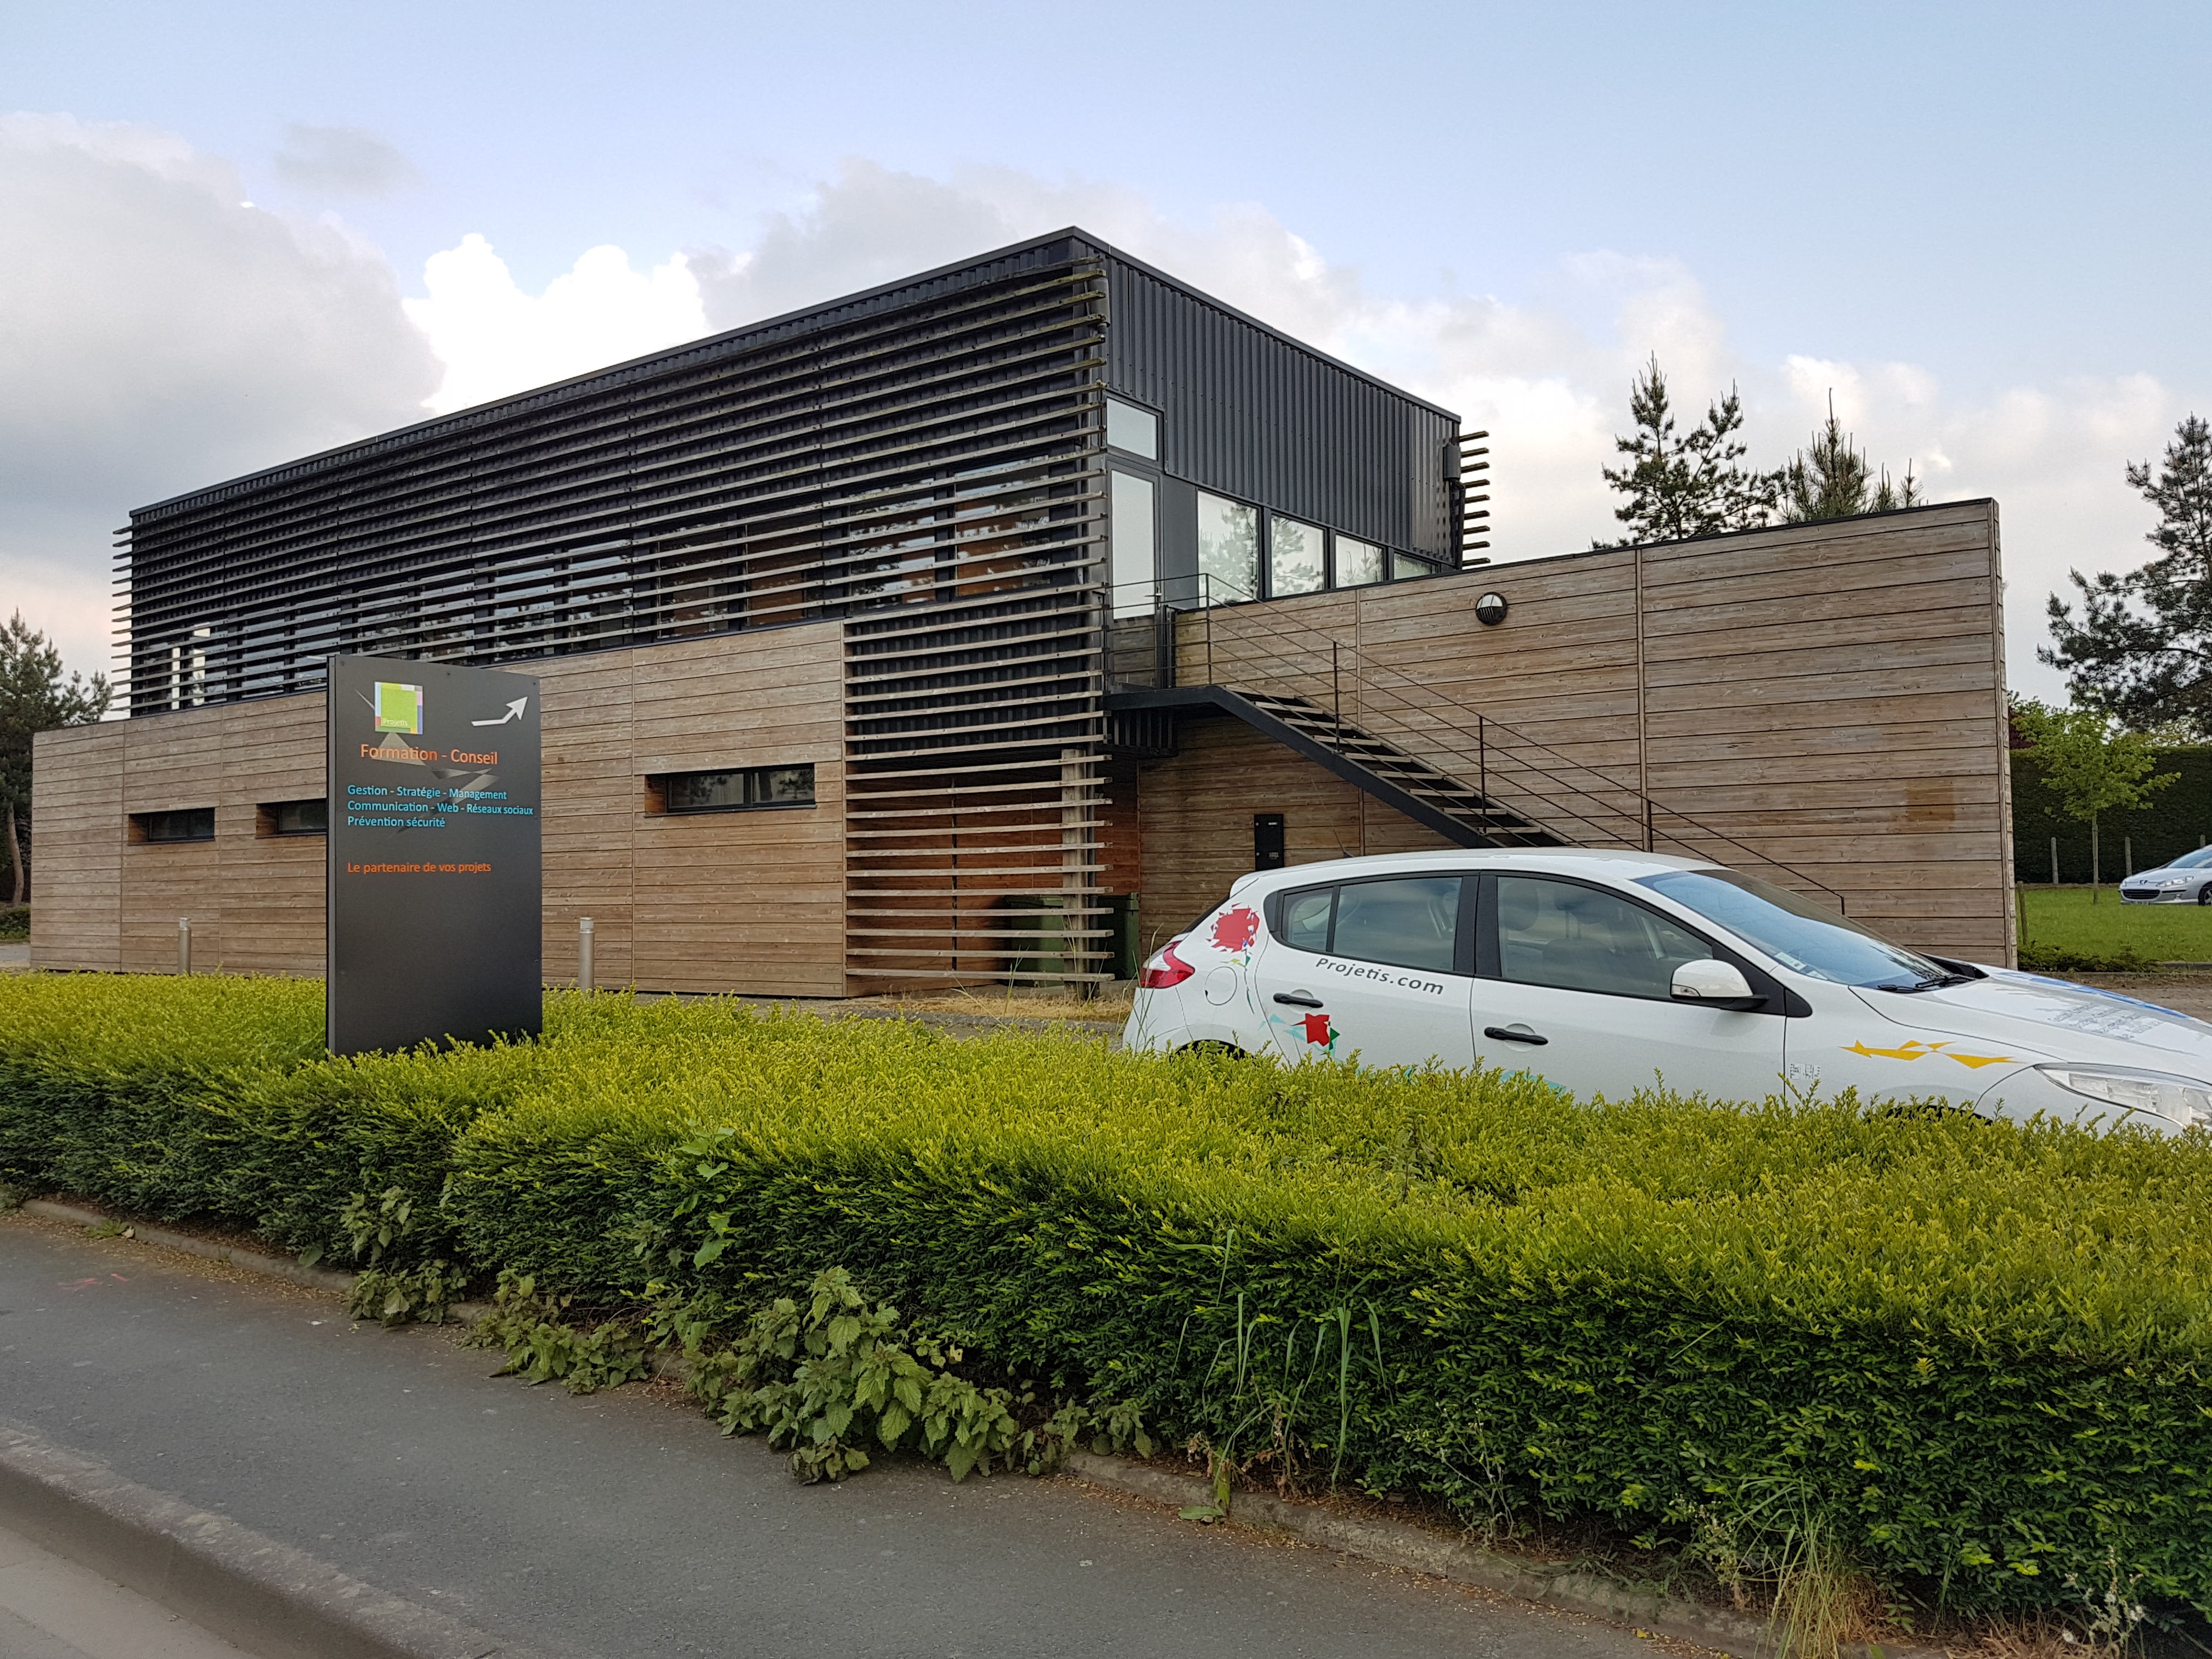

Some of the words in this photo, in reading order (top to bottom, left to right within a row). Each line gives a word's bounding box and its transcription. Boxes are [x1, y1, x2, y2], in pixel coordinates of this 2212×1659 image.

[360, 744, 438, 761] Formation
[450, 749, 498, 765] Conseil
[347, 785, 387, 795] Gestion
[397, 786, 441, 798] Stratégie
[449, 788, 507, 800] Management
[347, 800, 428, 812] Communication
[437, 803, 459, 813] Web
[466, 804, 502, 814] Réseaux
[504, 805, 533, 815] sociaux
[347, 816, 404, 826] Prévention
[406, 817, 445, 827] sécurité
[347, 862, 360, 872] Le
[363, 863, 421, 874] partenaire
[422, 863, 437, 872] de
[458, 862, 492, 873] projets
[1316, 958, 1444, 995] Projetis.com
